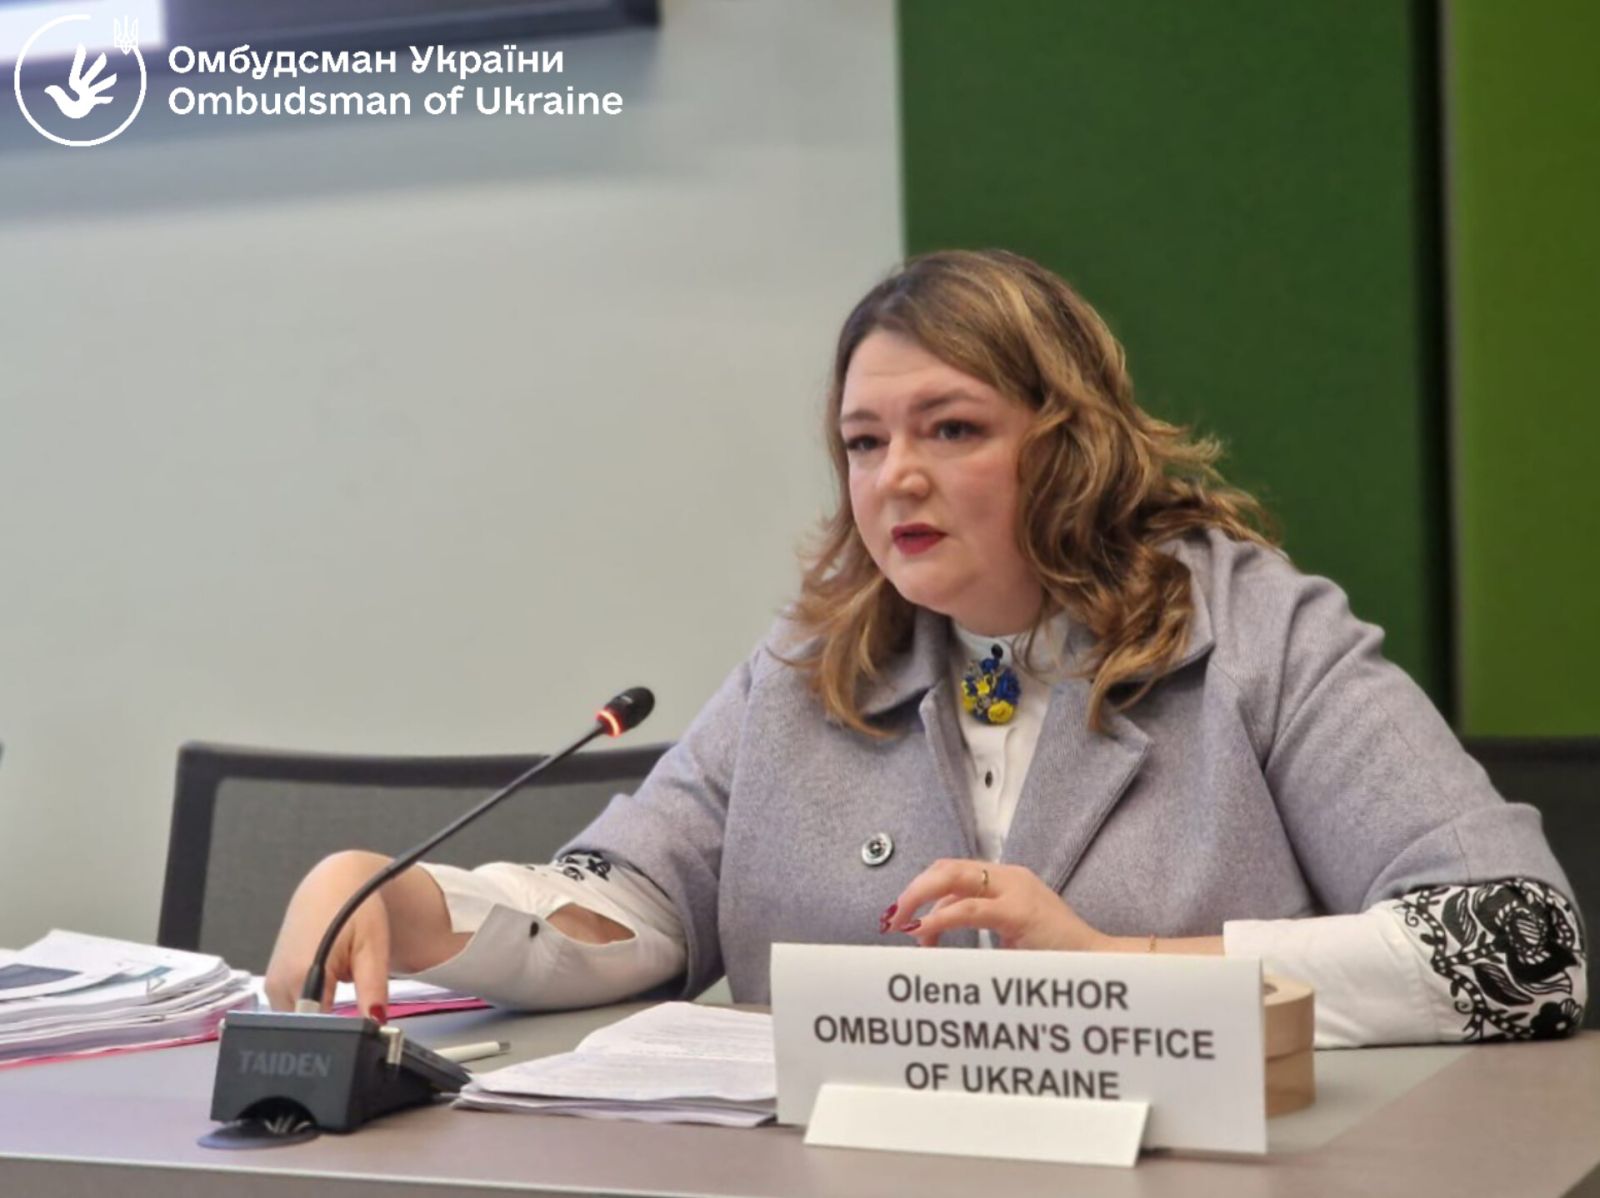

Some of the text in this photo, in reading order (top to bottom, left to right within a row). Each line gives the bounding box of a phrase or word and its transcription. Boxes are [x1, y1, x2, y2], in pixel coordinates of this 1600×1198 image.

[888, 974, 1129, 1010] Olena VIKHOR
[814, 1015, 1216, 1060] OMBUDSMAN'S OFFICE
[238, 1050, 332, 1078] TAIDEN
[905, 1062, 1121, 1100] OF UKRAINE
